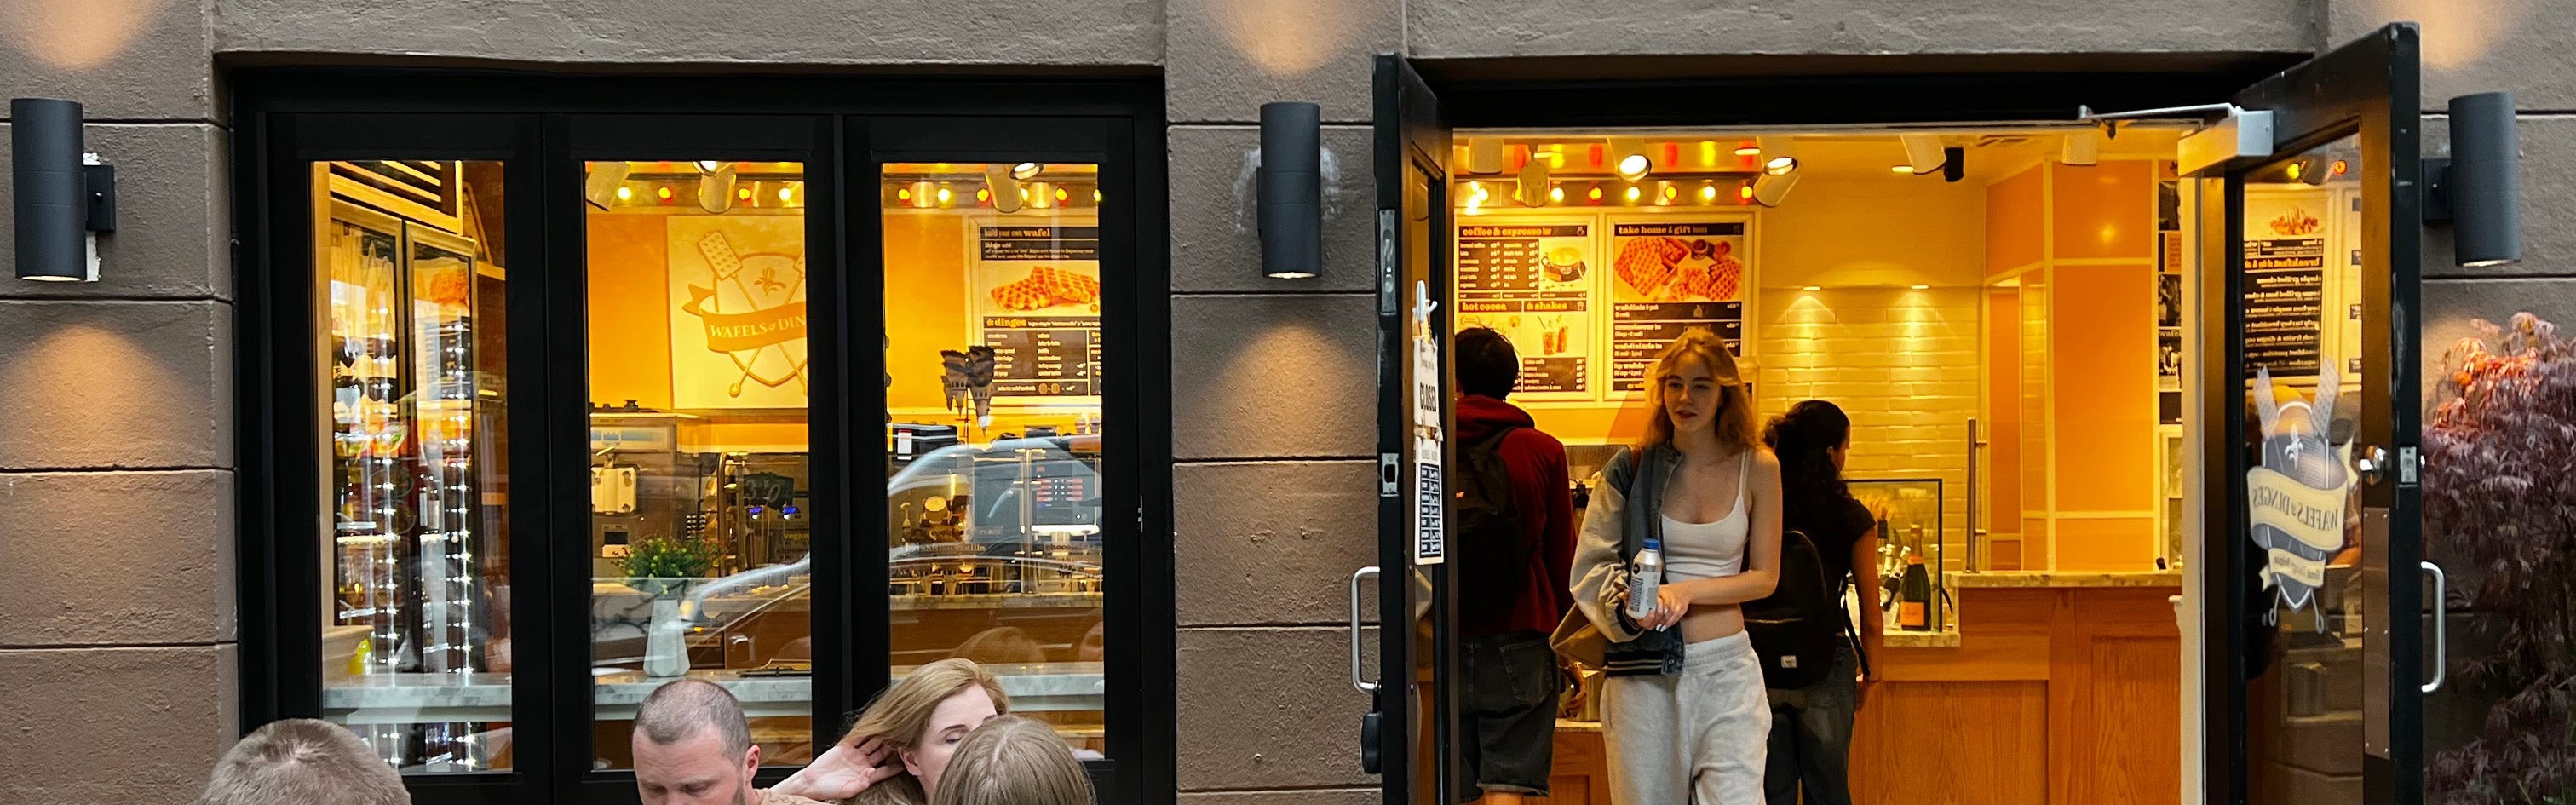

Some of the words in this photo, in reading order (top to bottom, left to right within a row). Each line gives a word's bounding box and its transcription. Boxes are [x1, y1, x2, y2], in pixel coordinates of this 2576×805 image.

[1023, 228, 1051, 237] wafel
[1462, 227, 1492, 236] coffee
[1493, 227, 1501, 236] &
[1502, 227, 1542, 238] espresso
[1619, 225, 1639, 234] take
[1641, 225, 1667, 234] home
[1674, 225, 1691, 235] gift
[1462, 302, 1479, 311] hot
[1480, 302, 1507, 311] cocoa
[1534, 301, 1568, 310] shakes
[995, 317, 1027, 328] dinges
[710, 321, 768, 339] WAFELS
[1420, 382, 1437, 412] CLOSED
